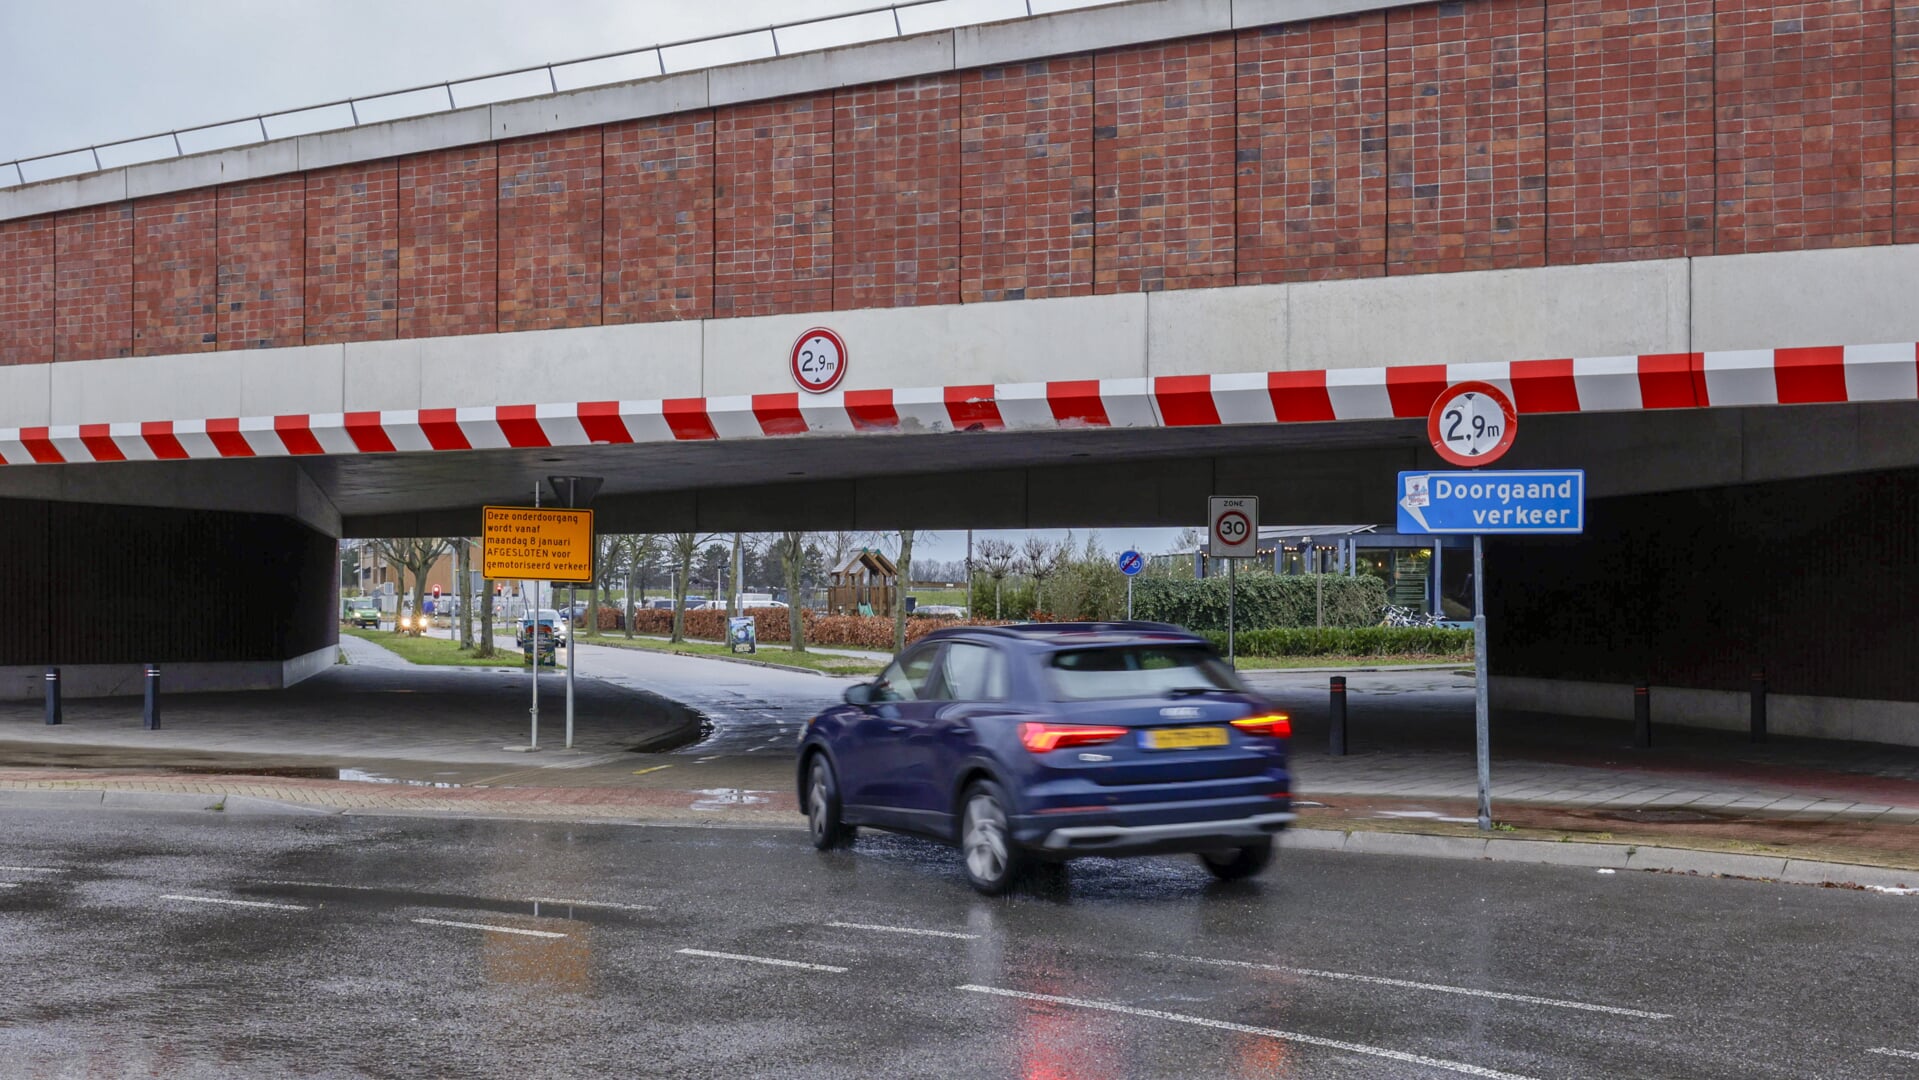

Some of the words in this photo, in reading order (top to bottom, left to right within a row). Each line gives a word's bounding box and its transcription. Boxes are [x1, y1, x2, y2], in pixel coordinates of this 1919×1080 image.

[1436, 479, 1571, 505] Doorgaand
[487, 511, 509, 520] Deze
[511, 512, 578, 524] onderdoorgang
[1473, 505, 1570, 525] verkeer
[487, 524, 512, 533] wordt
[515, 525, 540, 533] vanaf
[1222, 521, 1245, 535] 30
[487, 536, 527, 546] maandag
[530, 536, 536, 545] 8
[538, 538, 571, 547] januari
[487, 548, 549, 558] AFGESLOTEN
[551, 550, 571, 558] voor
[486, 561, 551, 570] gemotoriseerd
[553, 562, 587, 571] verkeer
